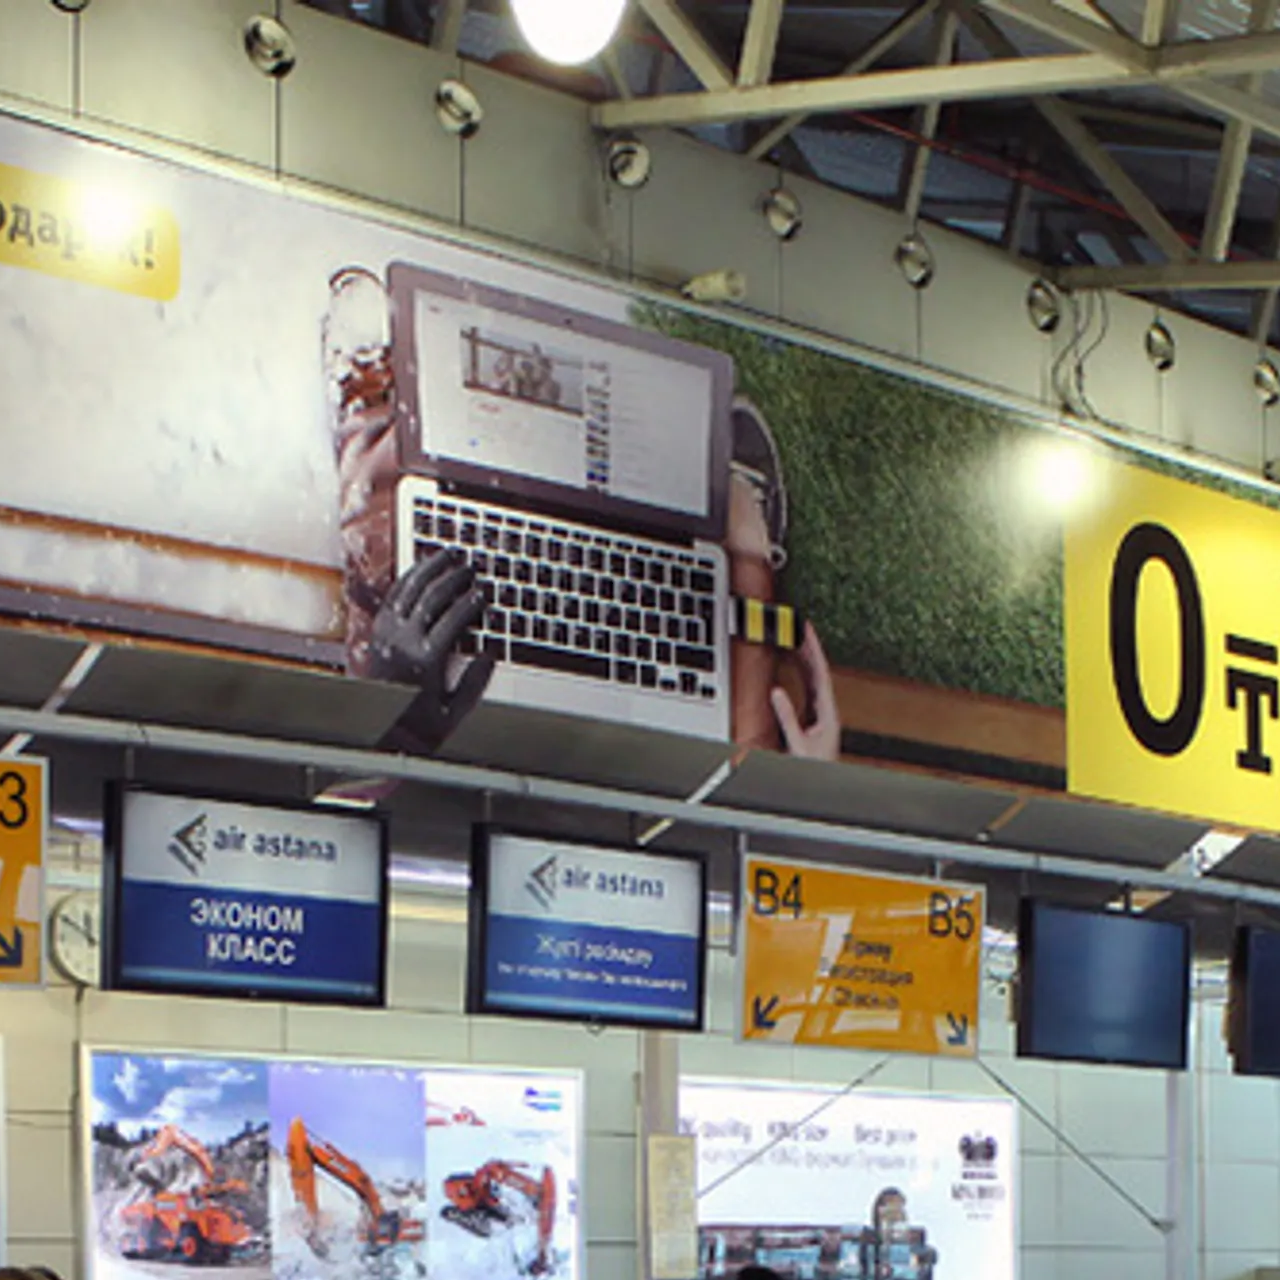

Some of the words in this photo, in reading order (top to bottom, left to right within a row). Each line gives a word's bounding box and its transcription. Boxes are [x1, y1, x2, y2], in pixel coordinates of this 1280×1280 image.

[213, 826, 247, 852] air
[252, 833, 338, 862] astana
[596, 871, 666, 899] astana
[754, 867, 803, 919] B4
[190, 898, 304, 934] ЭКОНОМ
[928, 890, 975, 940] B5
[207, 932, 296, 965] КЛАСС
